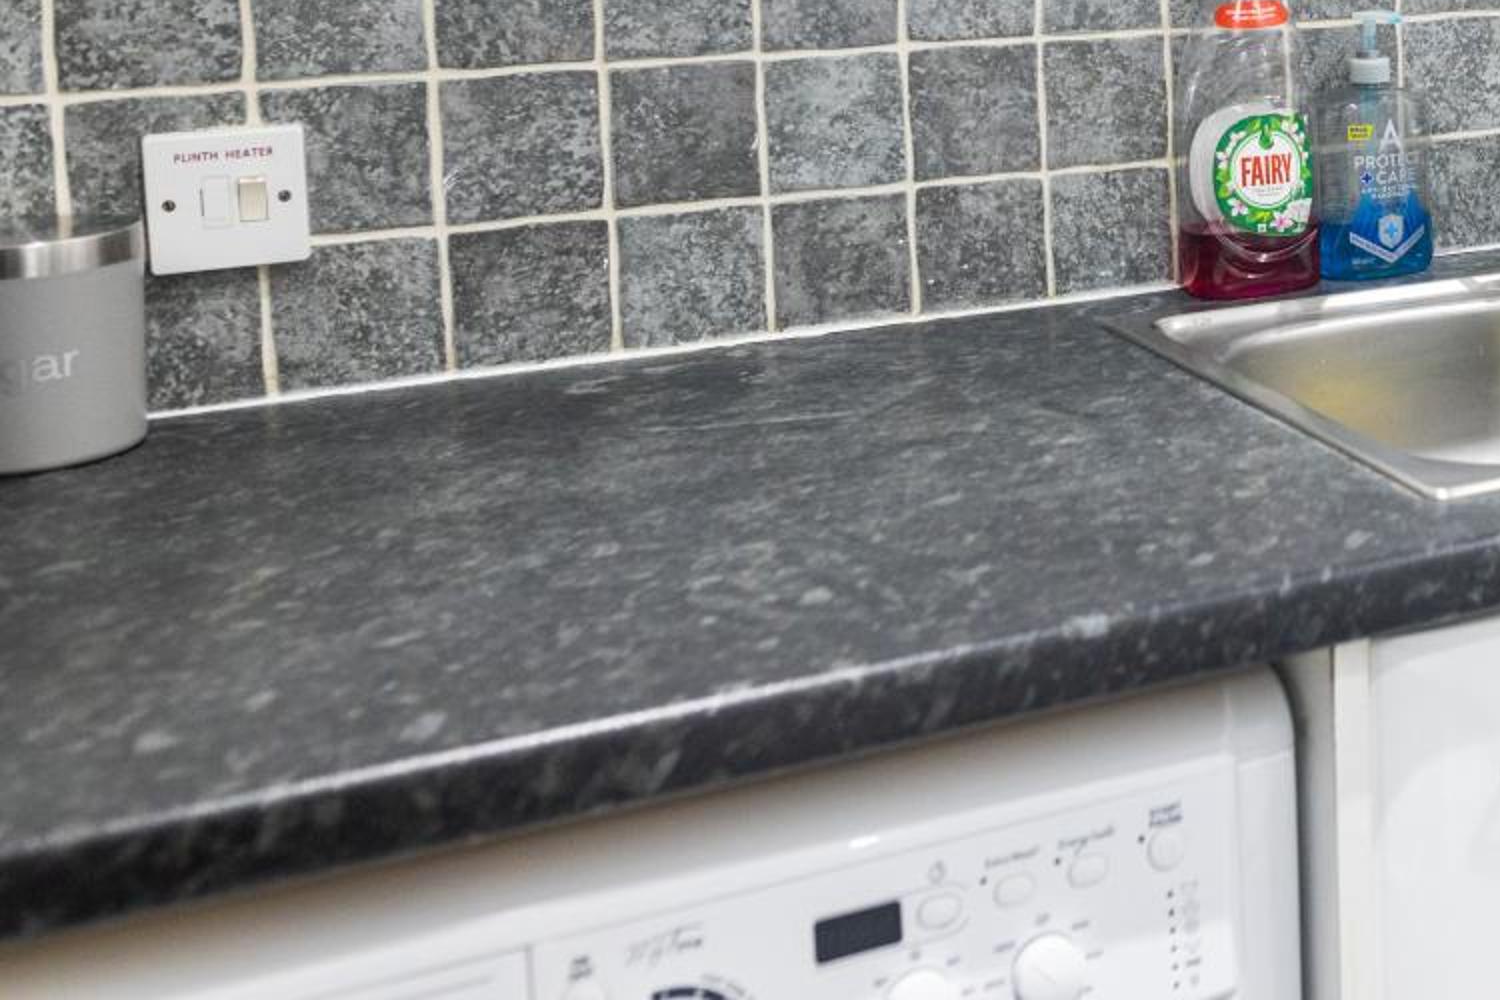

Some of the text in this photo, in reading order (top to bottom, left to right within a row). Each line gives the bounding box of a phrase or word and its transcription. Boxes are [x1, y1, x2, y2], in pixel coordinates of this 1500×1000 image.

[173, 145, 273, 163] PLINTH HEATER
[1241, 152, 1291, 187] FAIRY
